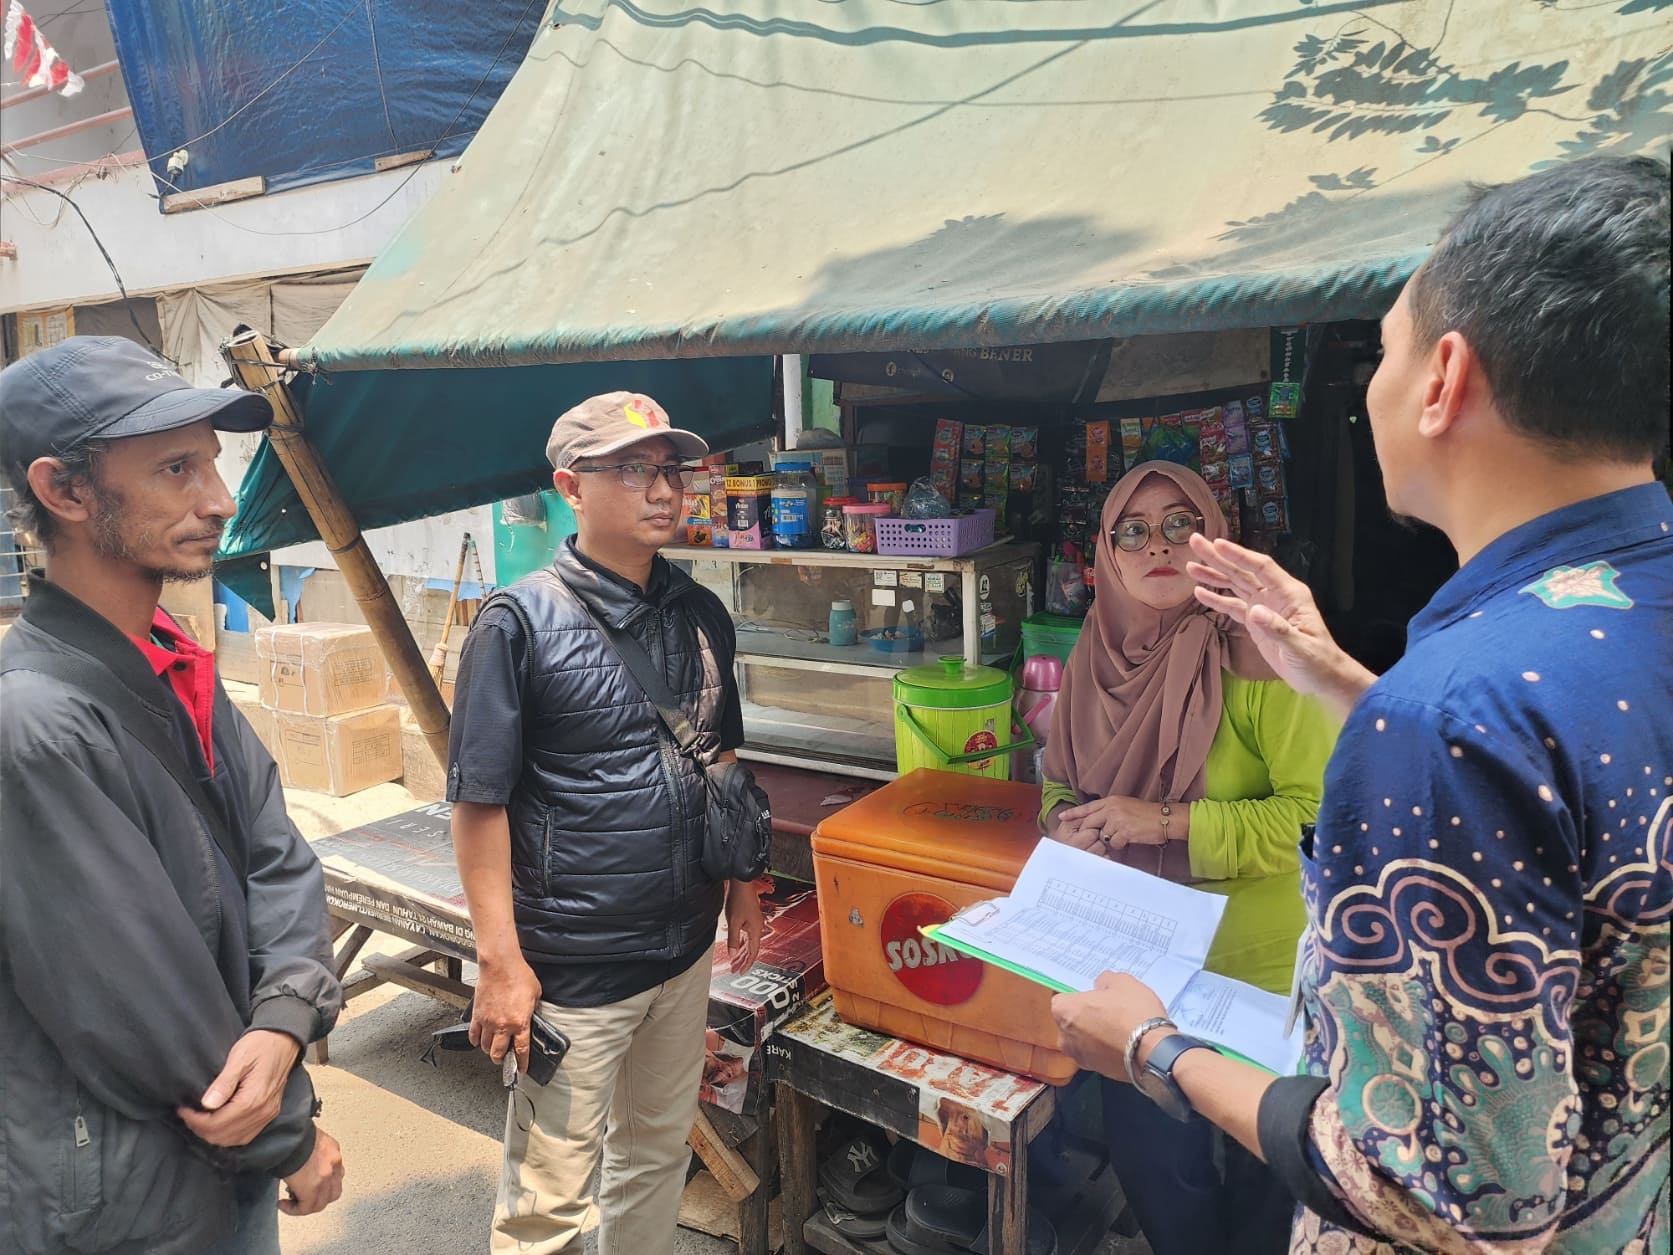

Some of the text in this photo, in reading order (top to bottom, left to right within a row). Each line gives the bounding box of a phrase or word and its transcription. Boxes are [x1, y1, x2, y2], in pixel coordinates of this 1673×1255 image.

[376, 900, 390, 912] DAN
[393, 905, 418, 920] TAHUN
[427, 917, 454, 934] BAWAH
[455, 926, 464, 937] DI
[886, 937, 973, 971] SOSR
